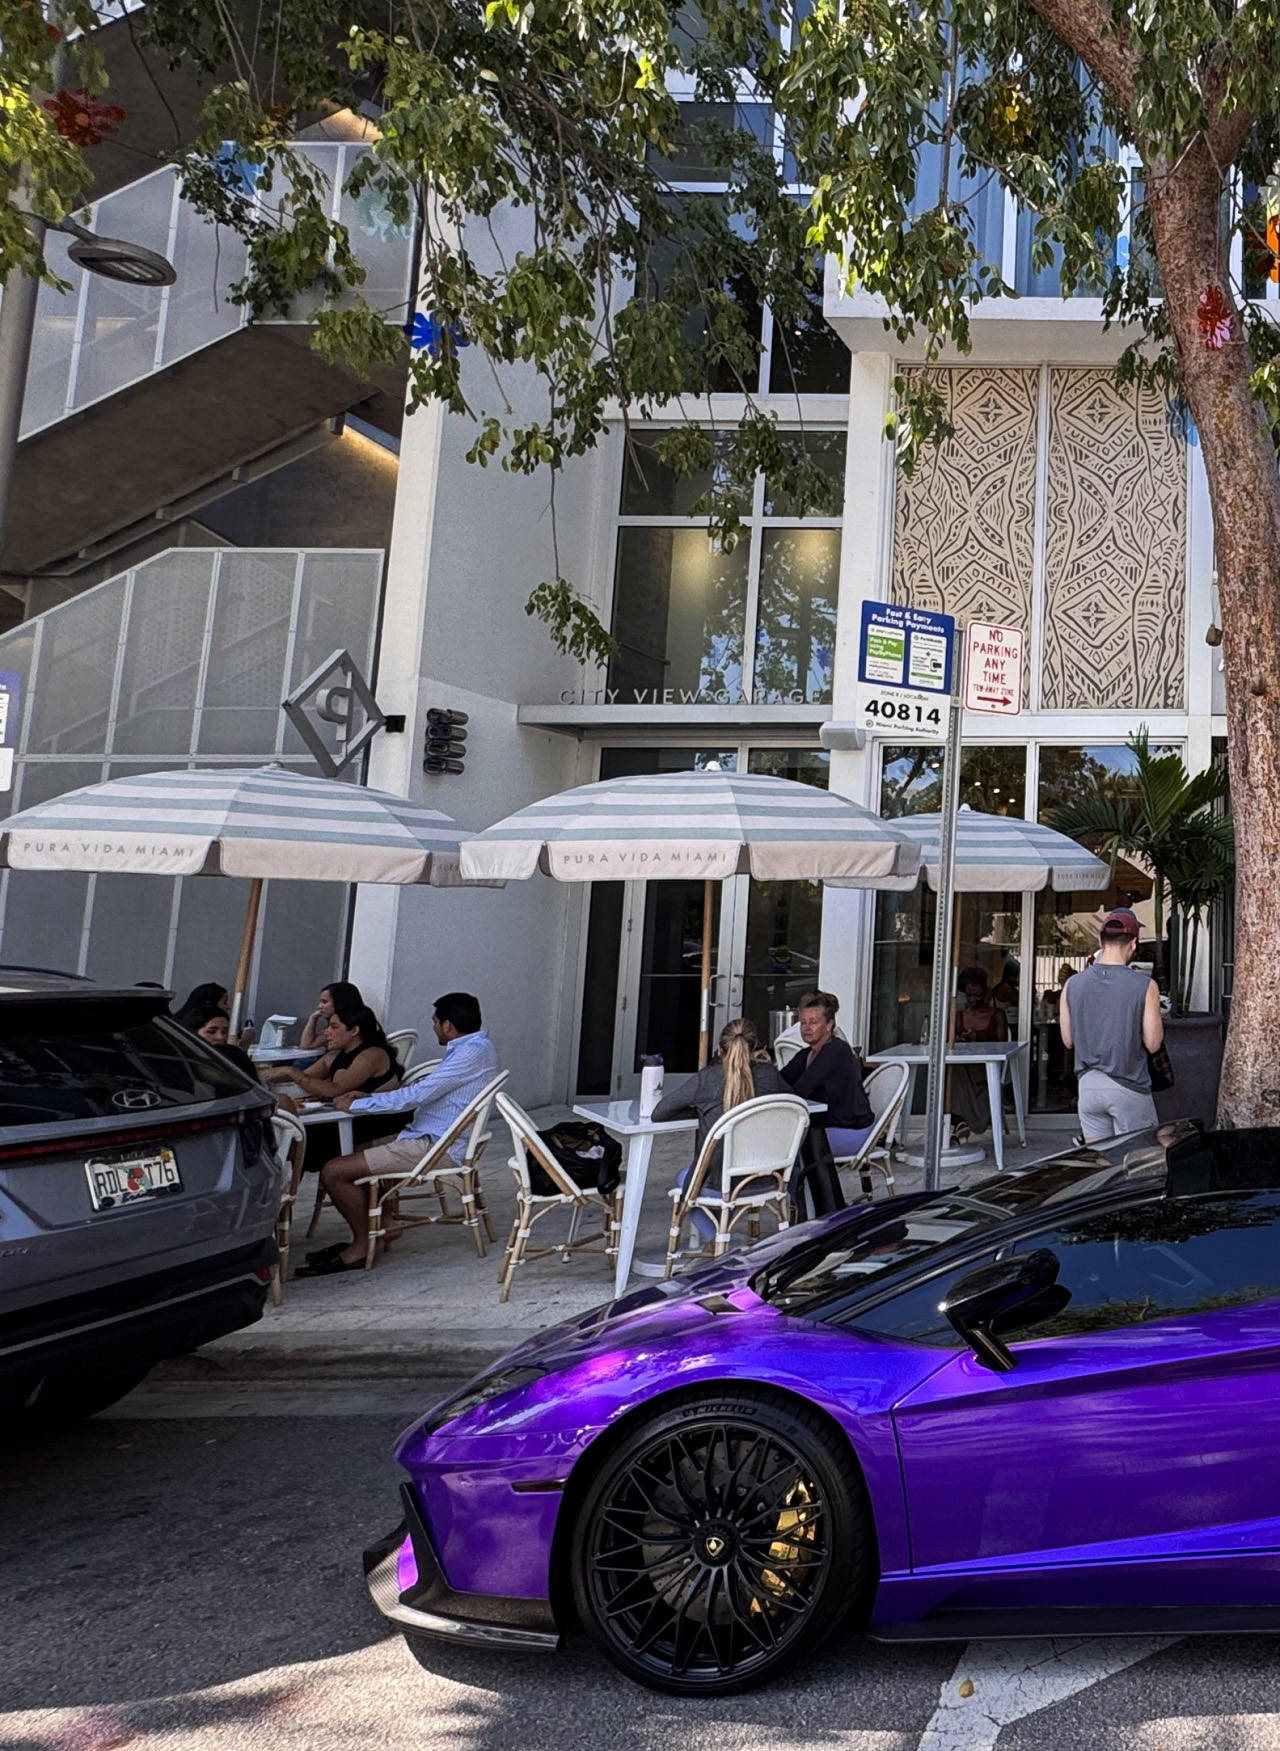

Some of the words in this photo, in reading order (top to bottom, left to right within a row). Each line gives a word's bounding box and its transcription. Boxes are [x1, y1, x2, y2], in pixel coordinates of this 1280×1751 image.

[872, 614, 904, 628] Parking
[906, 620, 945, 633] Payments
[886, 608, 903, 618] Fast
[913, 613, 932, 624] Easy
[989, 630, 1003, 642] NO
[973, 641, 1018, 659] PARKING
[984, 657, 1006, 670] ANY
[983, 671, 1007, 685] TIME
[559, 688, 620, 705] CITY
[634, 688, 700, 705] VIEW
[714, 688, 823, 705] GARAGE
[865, 700, 941, 725] 40814
[894, 724, 914, 732] Parking
[916, 727, 939, 735] Authority
[23, 842, 70, 853] PURA
[82, 843, 125, 854] VIDA
[136, 847, 195, 858] MIAMI
[563, 854, 608, 864] PURA
[619, 852, 661, 863] VIDA
[671, 851, 726, 862] MIAMI
[144, 1161, 176, 1187] T76
[698, 1403, 754, 1415] MICHELIN
